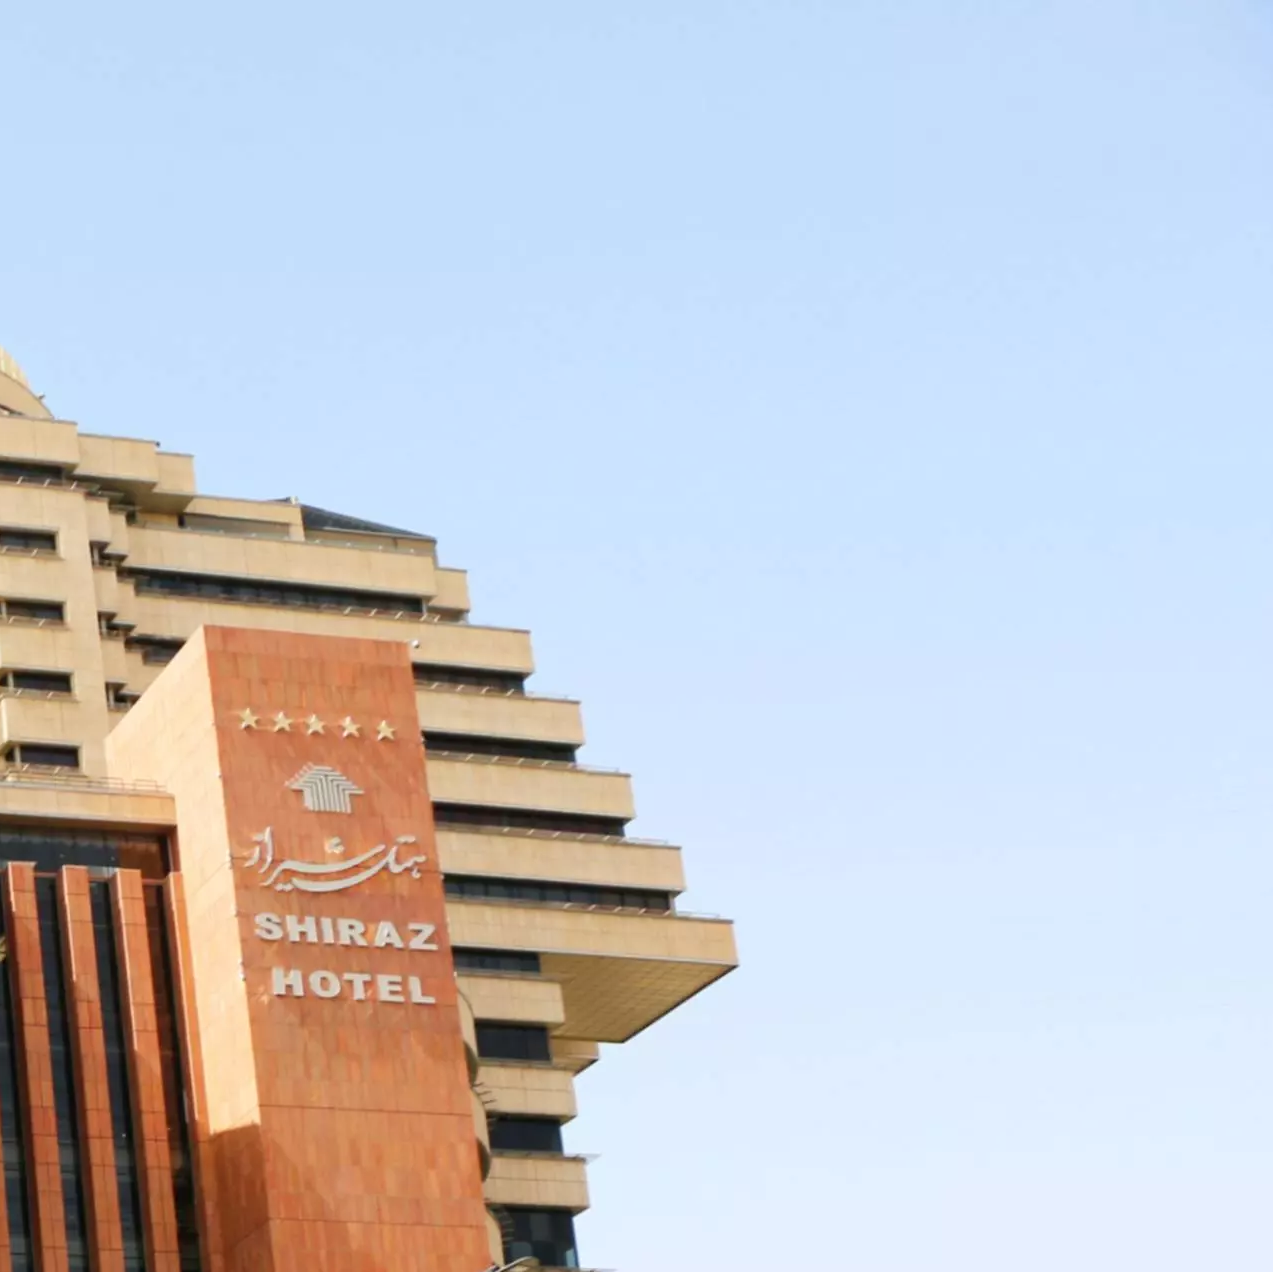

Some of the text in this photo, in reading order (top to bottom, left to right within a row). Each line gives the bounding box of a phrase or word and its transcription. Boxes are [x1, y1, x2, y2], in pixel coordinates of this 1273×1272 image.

[244, 826, 427, 892] هتل شیراز
[254, 911, 439, 951] SHIRAZ
[272, 966, 437, 1004] HOTEL
